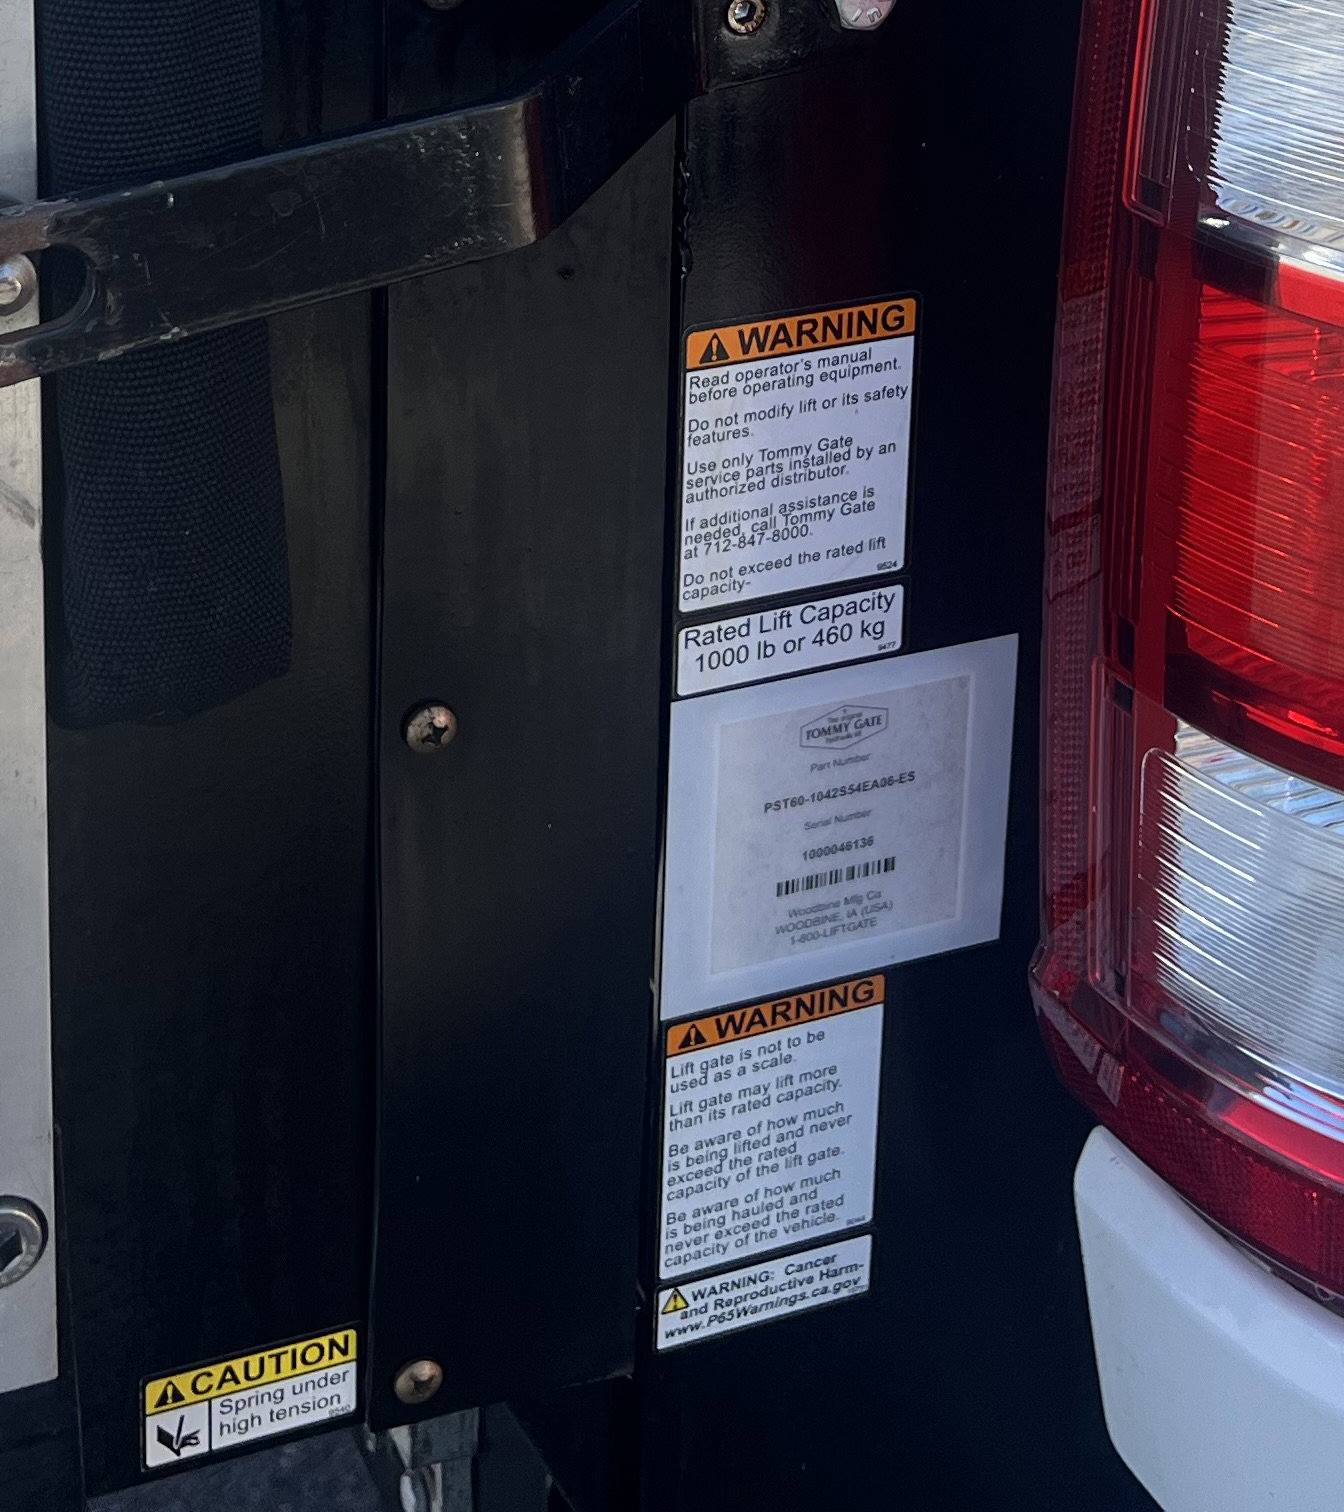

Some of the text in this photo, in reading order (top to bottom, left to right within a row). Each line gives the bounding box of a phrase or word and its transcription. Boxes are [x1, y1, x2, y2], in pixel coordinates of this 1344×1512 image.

[738, 304, 905, 355] WARNING
[689, 347, 872, 389] Read operator's manual
[689, 358, 902, 404] before operating equipment.
[688, 384, 909, 432] Do not modify lift or its safety
[687, 425, 754, 447] features.
[687, 435, 853, 475] Use only Tommy Gate
[686, 441, 897, 489] service parts installed by an
[686, 464, 849, 503] authorized distributor.
[684, 499, 876, 546] needed, call Tommy Gate
[686, 485, 875, 531] If additional assistance is
[683, 536, 886, 587] Do not exceed the rated lift
[684, 524, 813, 560] at 712-847-8000.
[684, 591, 896, 649] Rated Lift Capacity
[695, 619, 885, 673] 1000 lb or 460 kg
[806, 724, 850, 740] TOMMY
[854, 715, 882, 729] GATE
[810, 753, 872, 773] Part Number
[804, 809, 872, 830] Serial Number
[715, 980, 874, 1038] WARNING
[670, 1053, 796, 1093] used as a scale.
[671, 1029, 825, 1079] Lift gate is not to be
[669, 1064, 837, 1117] Lift gate may lift more
[669, 1077, 842, 1132] than its rated capacity.
[667, 1114, 853, 1172] is being lifted and never
[668, 1101, 844, 1158] Be aware of how much
[667, 1141, 797, 1187] exceed the rated
[667, 1146, 845, 1202] capacity of the lift gate.
[666, 1167, 841, 1225] Be aware of how much
[666, 1188, 818, 1240] is being hauled and
[665, 1194, 845, 1254] never exceed the rated
[664, 1243, 729, 1268] capacity
[734, 1234, 750, 1249] of
[754, 1228, 777, 1244] the
[680, 1301, 708, 1320] and
[713, 1276, 814, 1311] Reproductive
[691, 1254, 837, 1301] WARNING: Cancer
[665, 1276, 862, 1339] www.P65Warnings.ca.gov
[191, 1335, 349, 1395] CAUTION
[219, 1370, 350, 1416] Spring under
[219, 1393, 341, 1437] high tension
